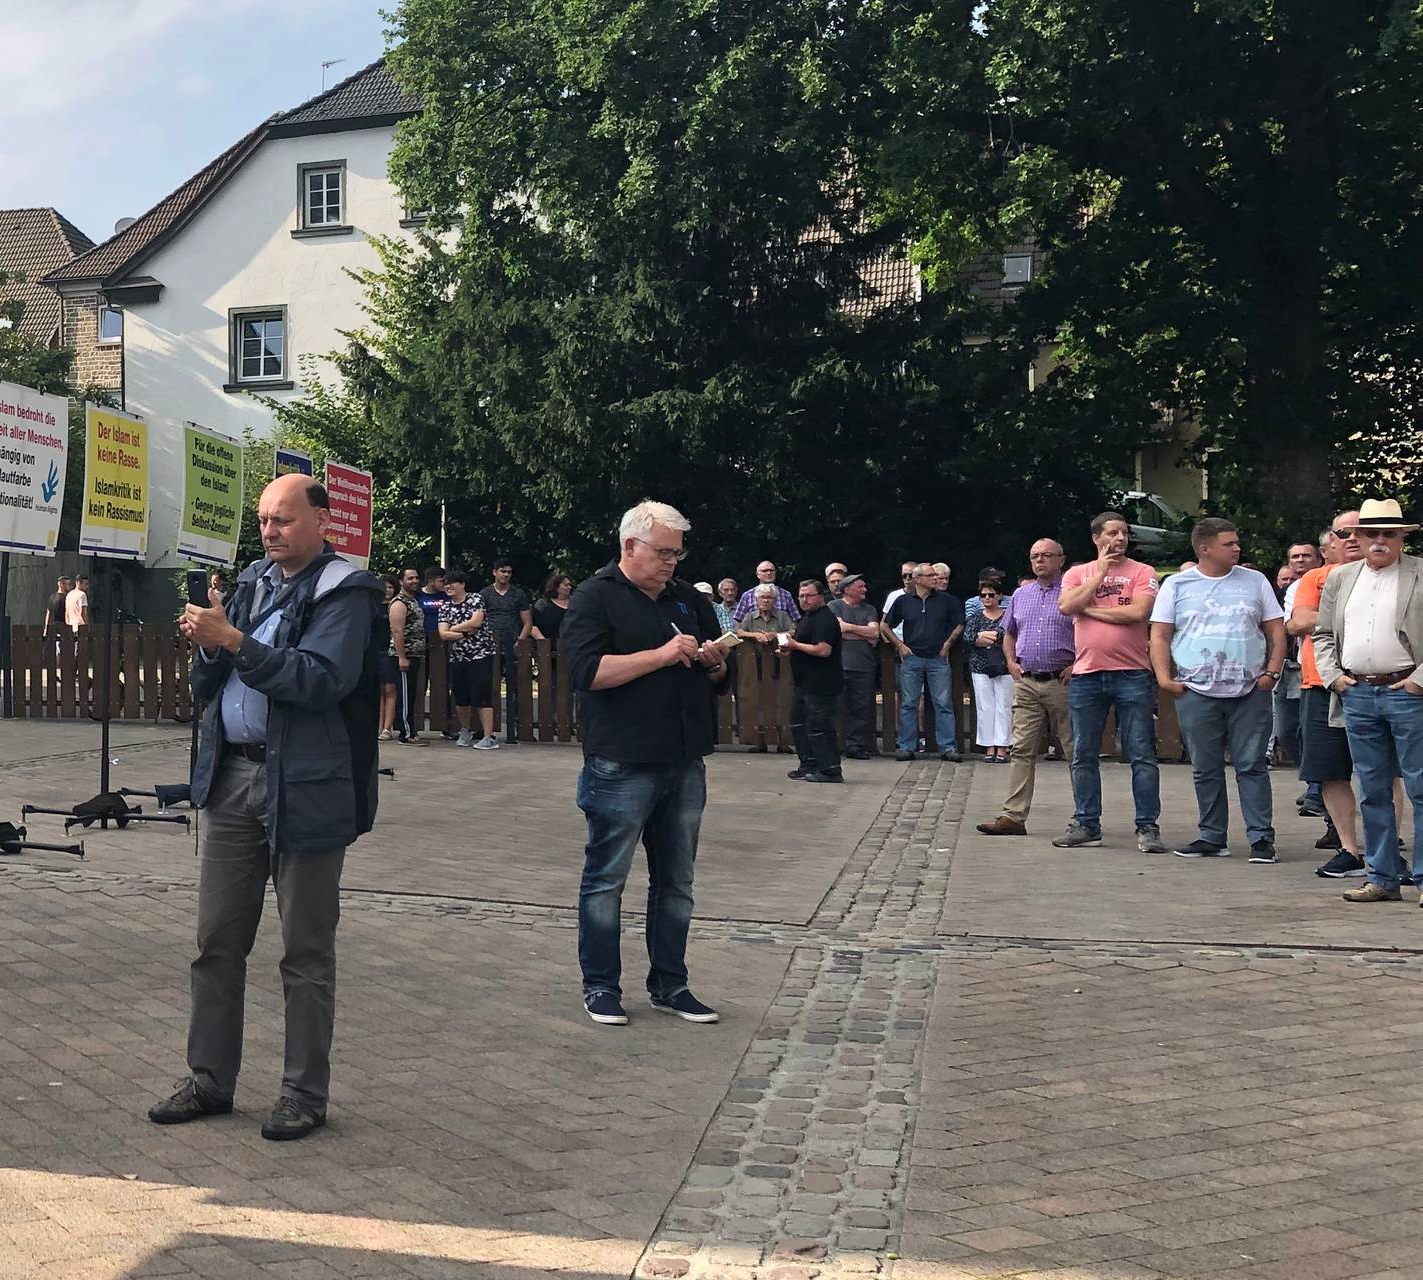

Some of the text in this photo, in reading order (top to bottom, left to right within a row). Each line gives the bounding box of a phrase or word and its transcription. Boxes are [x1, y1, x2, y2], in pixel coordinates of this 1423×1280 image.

[17, 405, 43, 423] bedroht
[45, 412, 55, 426] die
[10, 426, 26, 440] aller
[27, 431, 64, 452] Menschen,
[98, 422, 140, 447] Der Islam ist
[23, 453, 35, 466] von
[98, 448, 140, 469] keine Rasse.
[194, 438, 233, 462] Für die offene
[193, 453, 236, 479] Diskussion über
[95, 477, 141, 500] Islamkritik ist
[201, 475, 211, 488] den
[89, 498, 144, 522] kein Rassismus!
[195, 497, 213, 513] Gegen
